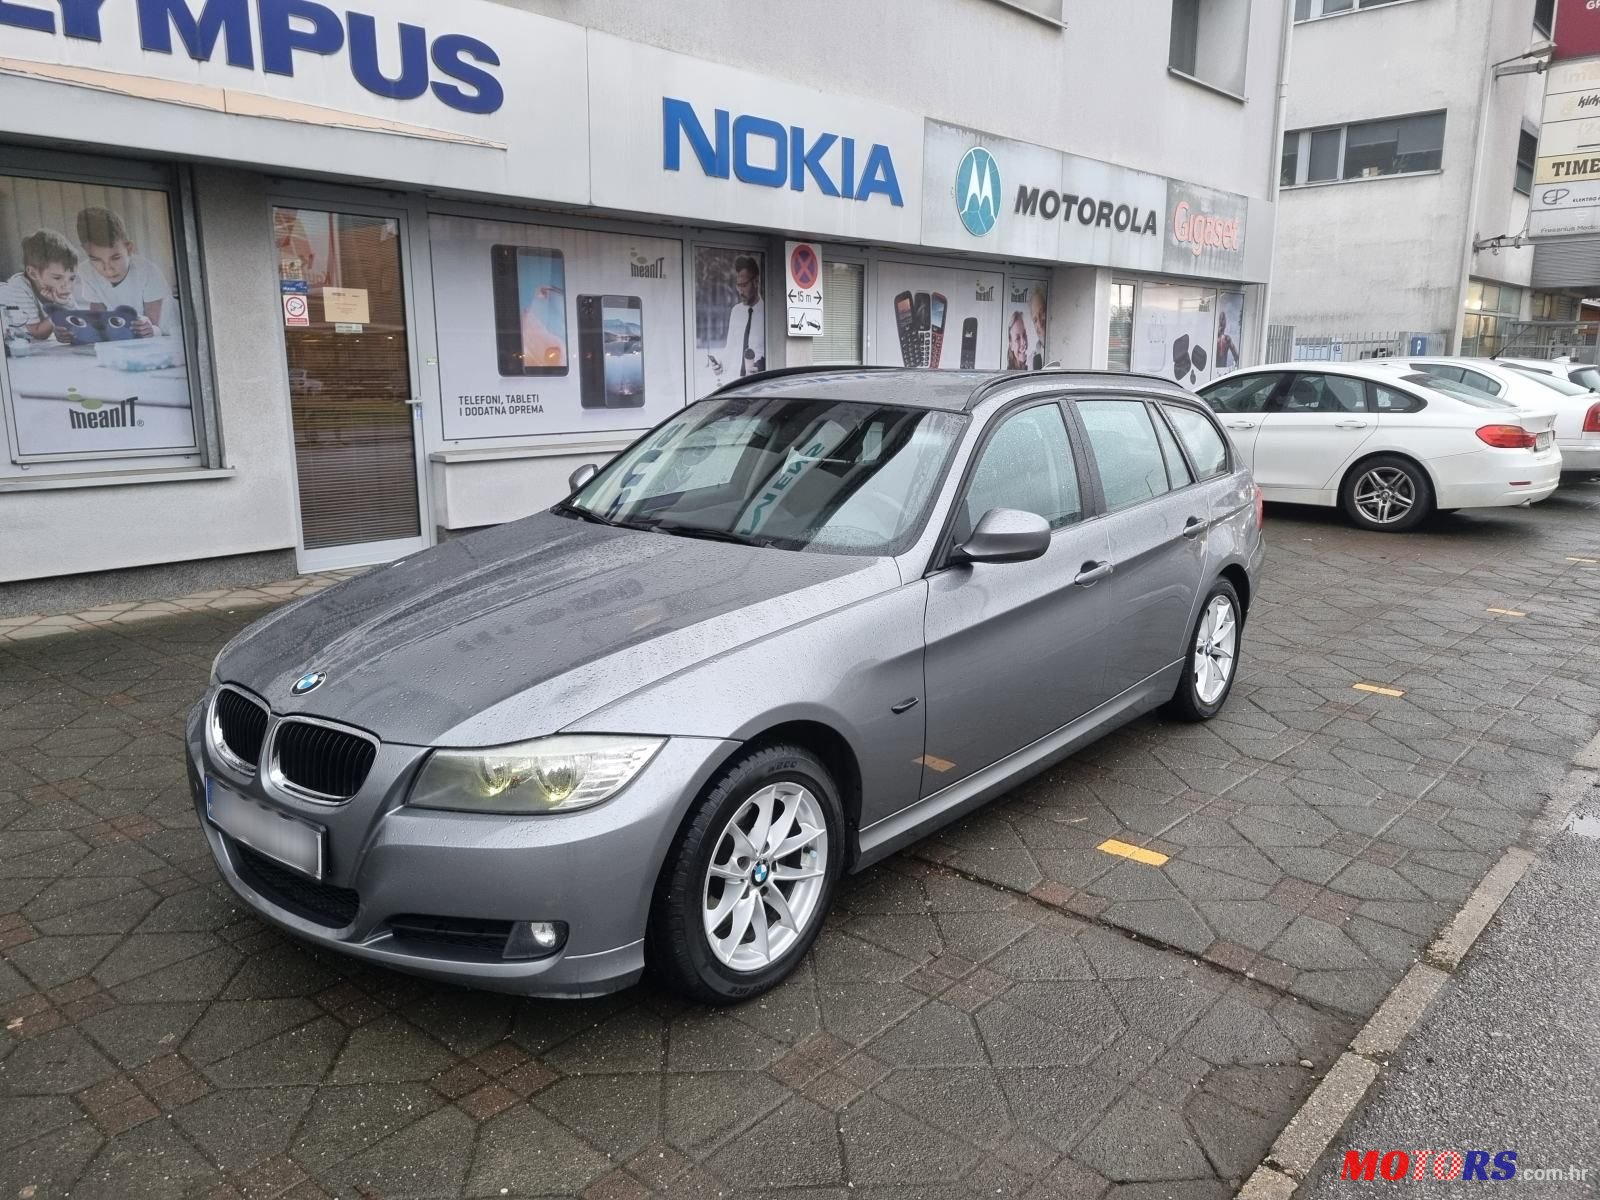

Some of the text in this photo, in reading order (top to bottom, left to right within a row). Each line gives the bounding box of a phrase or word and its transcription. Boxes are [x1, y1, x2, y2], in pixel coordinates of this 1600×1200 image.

[663, 96, 904, 208] NOKIA
[1014, 184, 1157, 236] MOTOROLA
[1174, 201, 1240, 256] Gigaset
[797, 291, 812, 303] 15 m
[458, 393, 540, 405] TELEFONI, TABLETI
[459, 405, 544, 416] I DODATNA OPREMA
